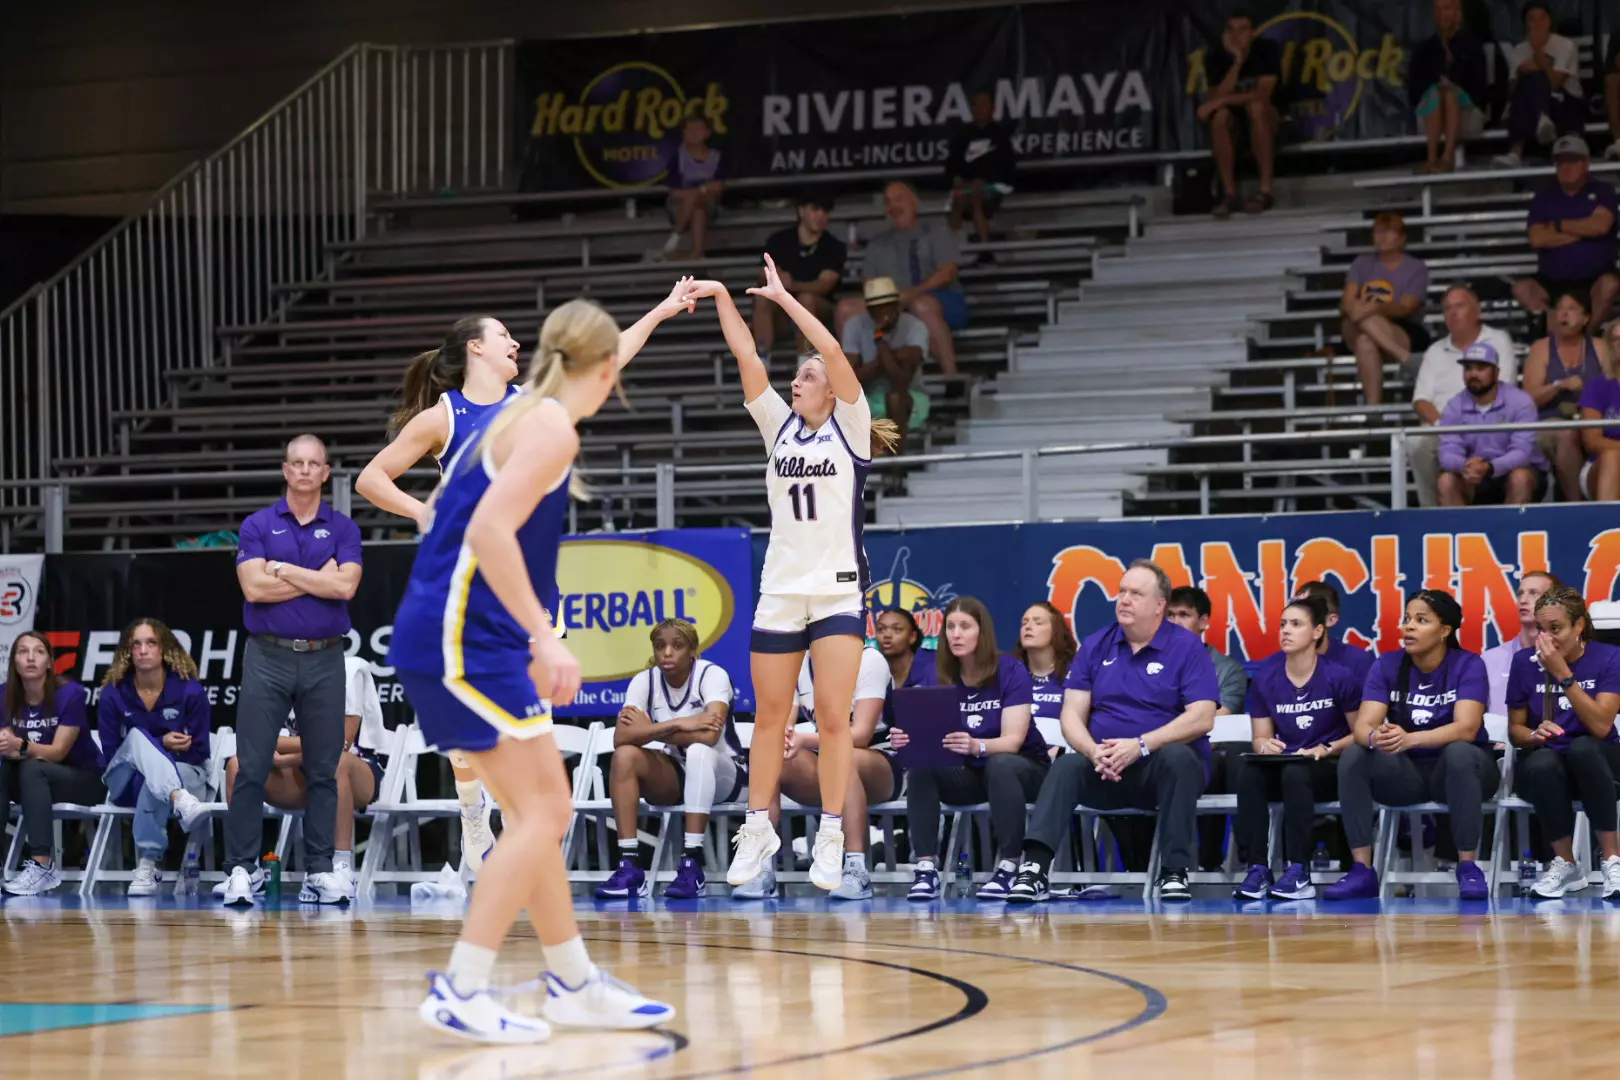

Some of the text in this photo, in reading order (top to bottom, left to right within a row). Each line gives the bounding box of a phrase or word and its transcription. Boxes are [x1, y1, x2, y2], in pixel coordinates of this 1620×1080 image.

[1300, 32, 1405, 93] Rock
[530, 89, 630, 137] Hard
[762, 69, 1153, 136] RIVIERA MAYA
[770, 150, 806, 172] AN
[812, 138, 950, 169] ALL-INCLUS
[1009, 127, 1144, 155] XPERIENCE
[774, 455, 838, 478] Wildcats
[787, 483, 818, 522] 11
[1276, 698, 1334, 714] WILDCATS
